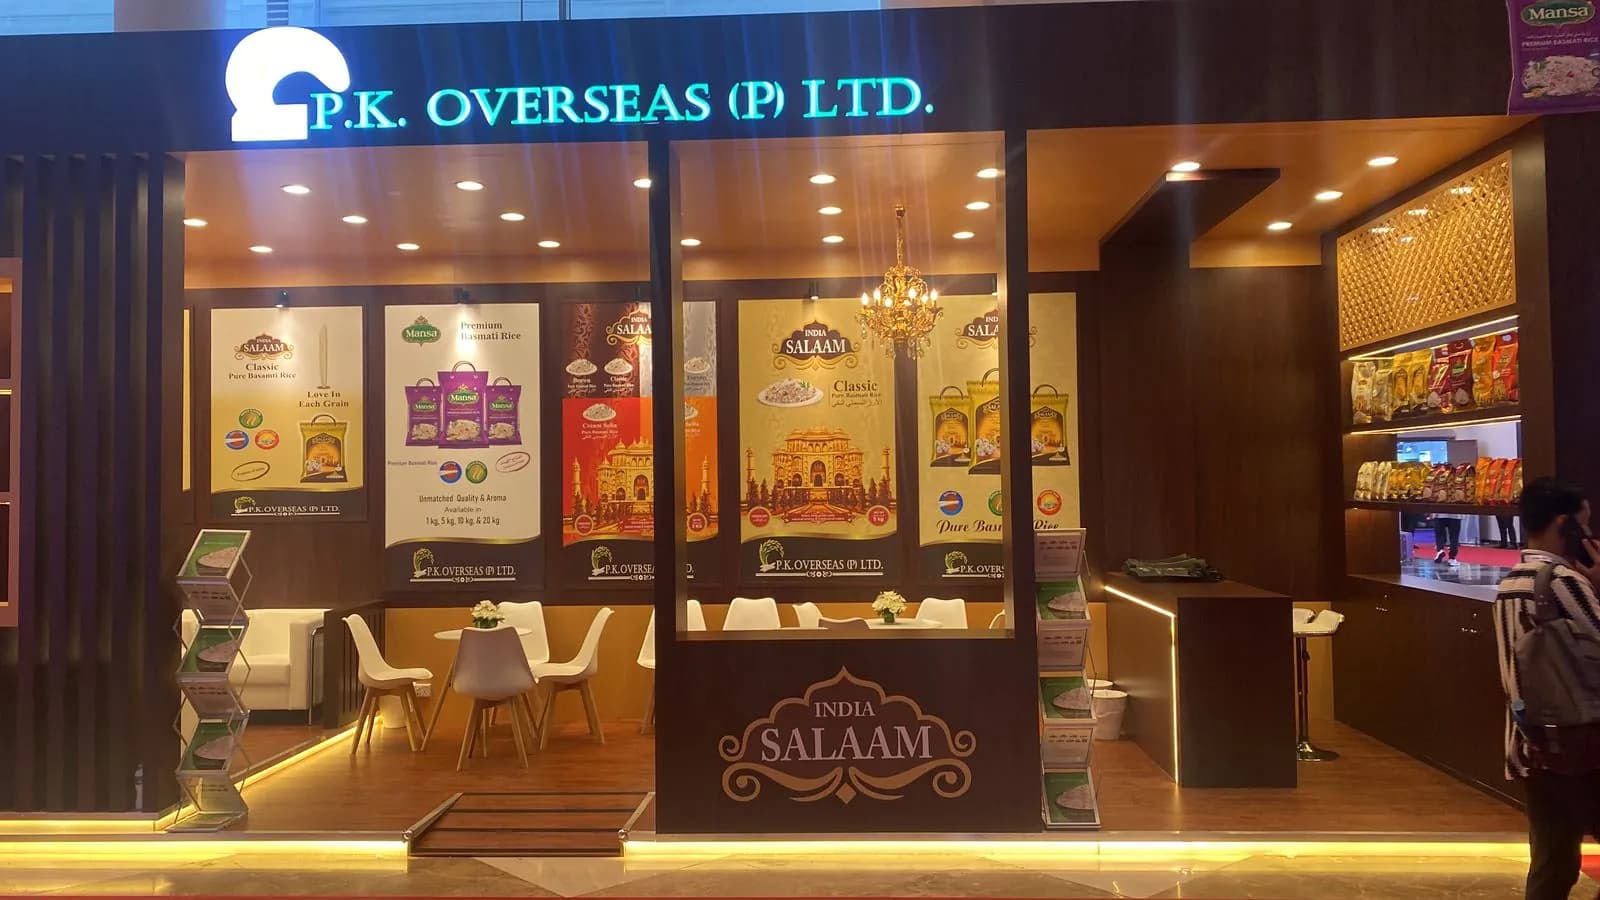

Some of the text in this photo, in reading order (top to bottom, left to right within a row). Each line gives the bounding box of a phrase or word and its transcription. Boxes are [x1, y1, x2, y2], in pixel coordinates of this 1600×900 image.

[1529, 6, 1589, 20] Mansa
[309, 76, 935, 131] P.K. OVERSEAS (P) LTD.
[460, 321, 503, 330] Premium
[616, 324, 652, 335] SALAA
[968, 324, 999, 337] SALA
[405, 328, 438, 338] Mansa
[460, 331, 521, 341] Basmati Rice
[804, 329, 827, 337] INDIA
[243, 343, 285, 352] SALAAM
[786, 339, 846, 354] SALAAM
[245, 362, 280, 371] Classic
[228, 372, 246, 380] Pure
[280, 371, 297, 379] Rice
[833, 379, 878, 392] Classic
[307, 390, 341, 399] Love In
[450, 393, 477, 402] Mansa
[299, 399, 350, 408] Each Grain
[491, 402, 512, 410] Mansa
[419, 494, 507, 503] Unmatched Quality & Aroma
[444, 506, 474, 514] Available
[425, 516, 430, 525] 1
[441, 516, 446, 525] 5
[457, 516, 464, 525] 10
[482, 516, 491, 525] 20
[937, 519, 969, 534] Pure
[847, 559, 858, 570] (P)
[860, 558, 884, 570] LTD.
[485, 565, 495, 576] (P)
[497, 565, 517, 576] LTD.
[813, 700, 876, 719] INDIA
[760, 724, 933, 763] SALAAM
